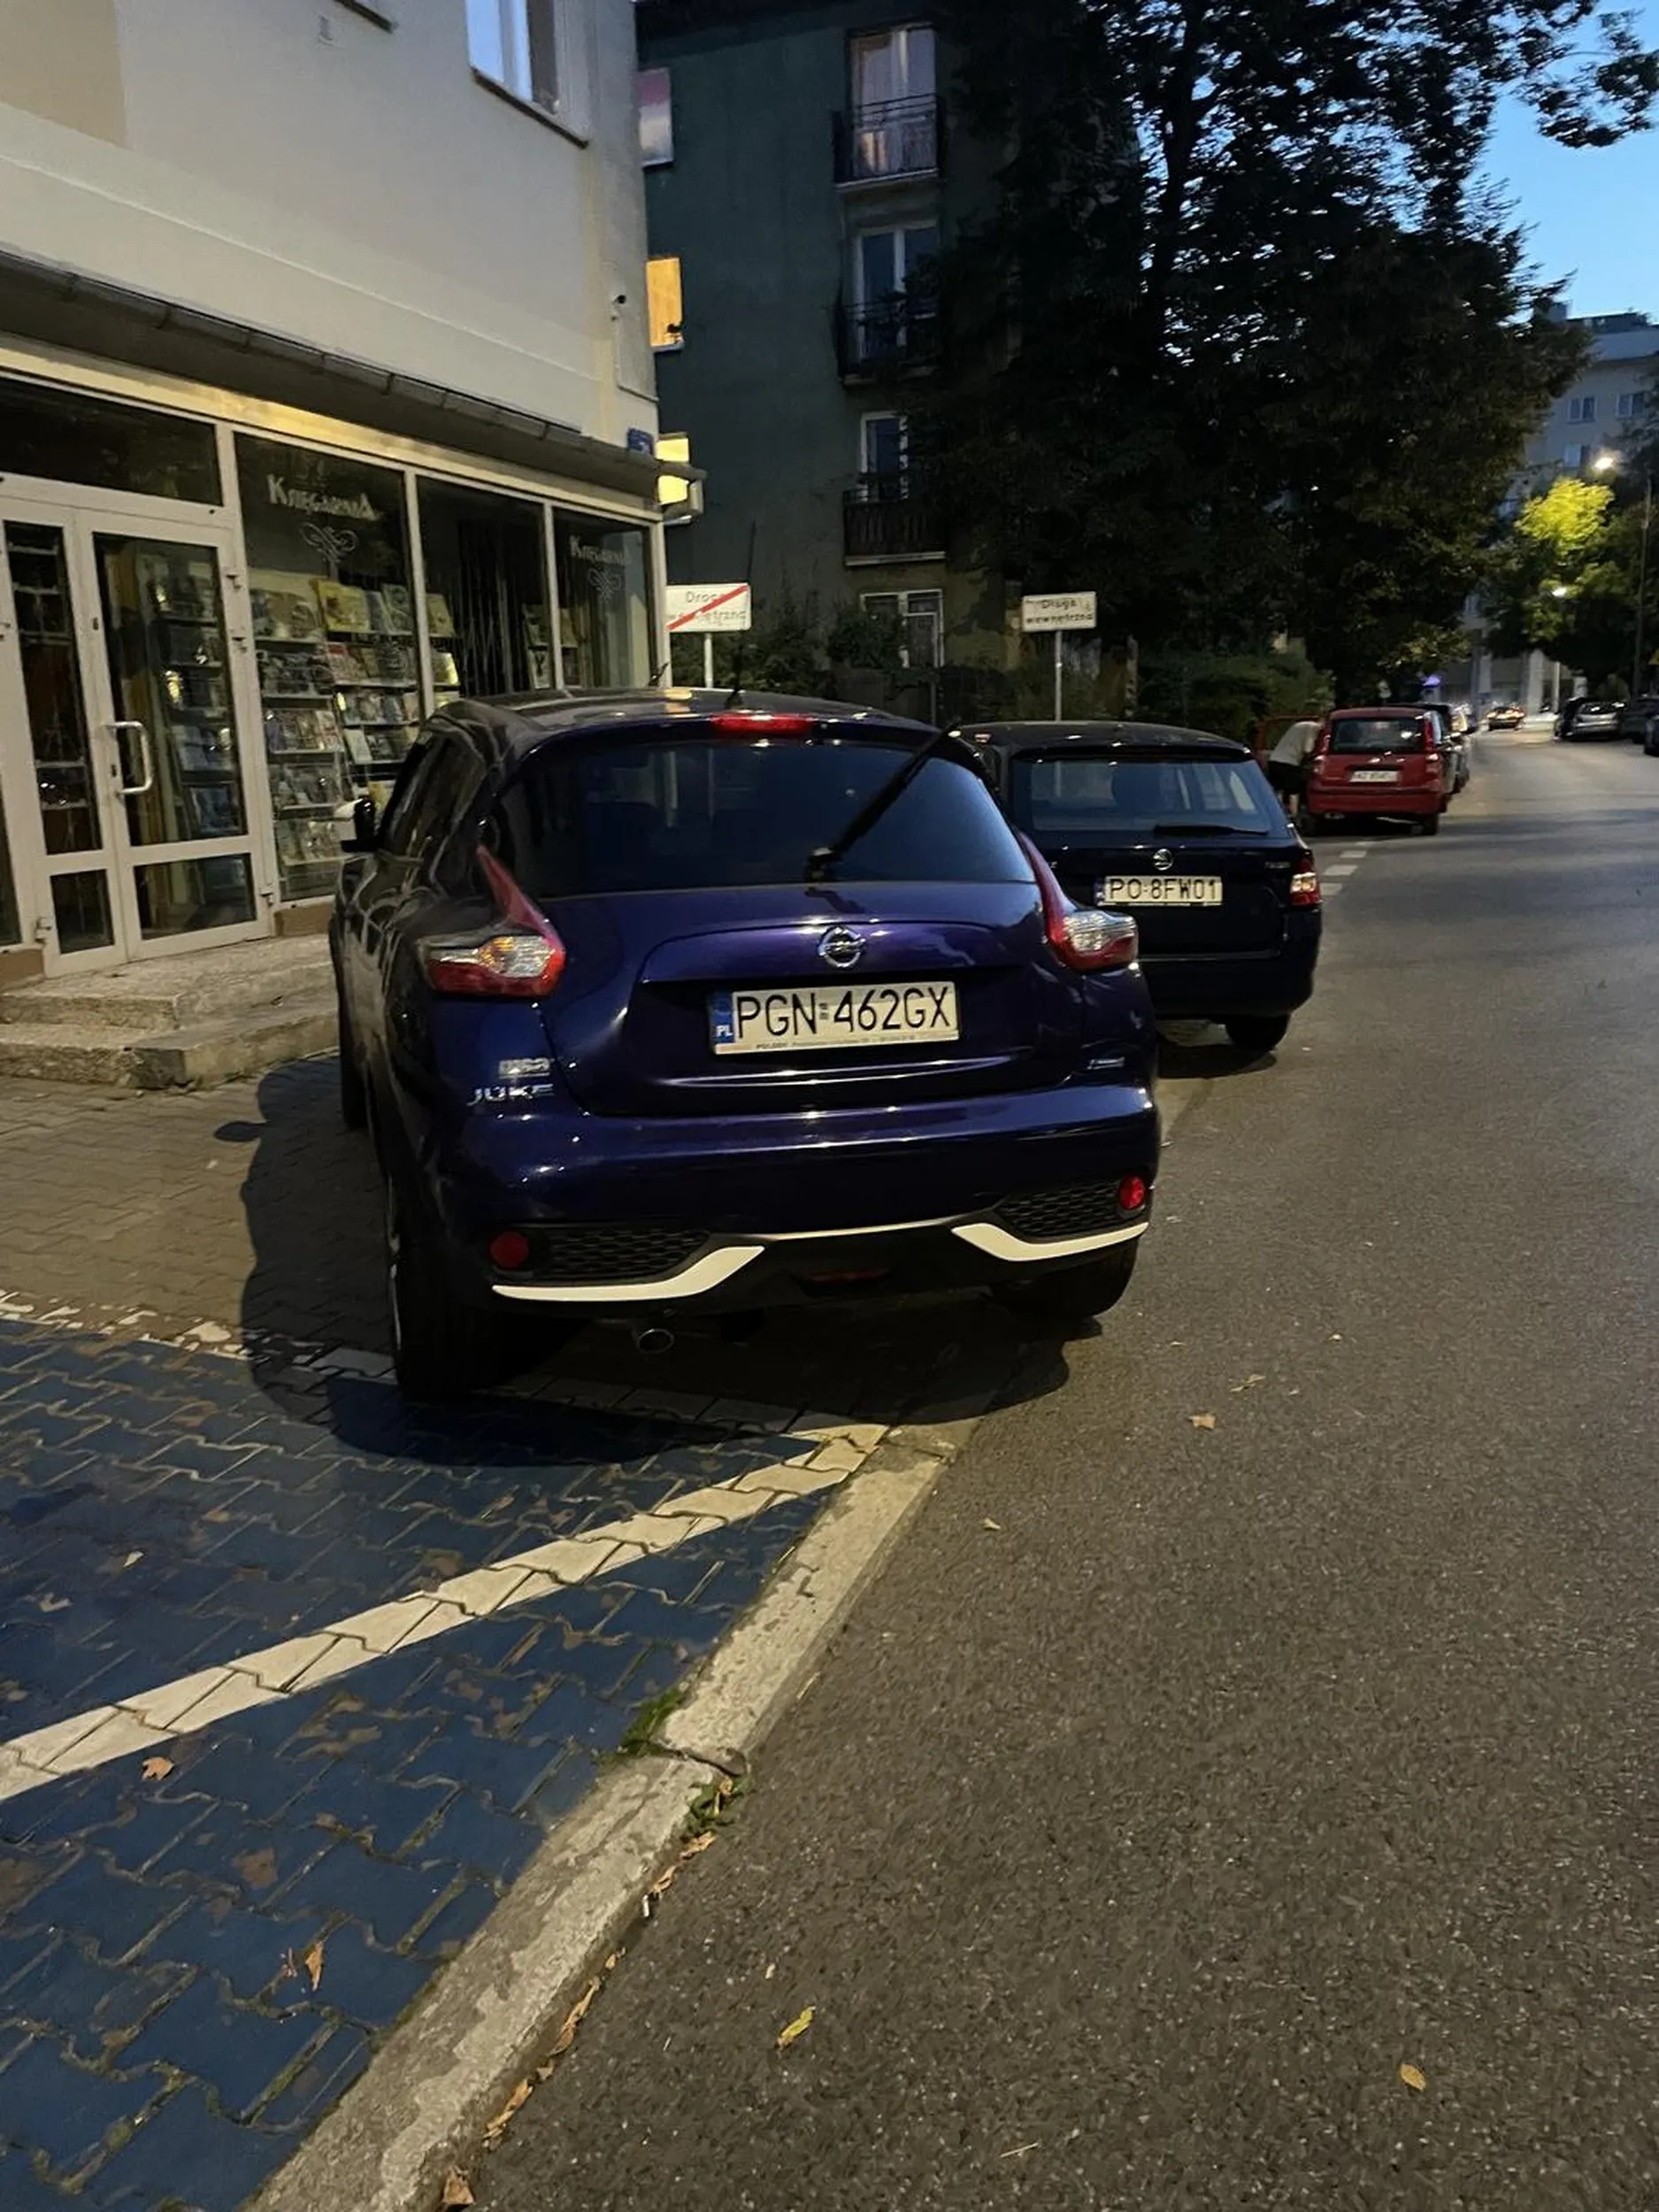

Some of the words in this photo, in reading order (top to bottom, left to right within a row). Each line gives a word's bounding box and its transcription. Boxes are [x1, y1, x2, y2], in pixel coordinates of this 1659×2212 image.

[1110, 879, 1141, 900] PO
[1150, 879, 1217, 900] 8FW01
[736, 992, 818, 1039] PGN
[833, 987, 950, 1033] 462GX
[716, 1025, 733, 1037] PL
[467, 1084, 553, 1106] JUKE
